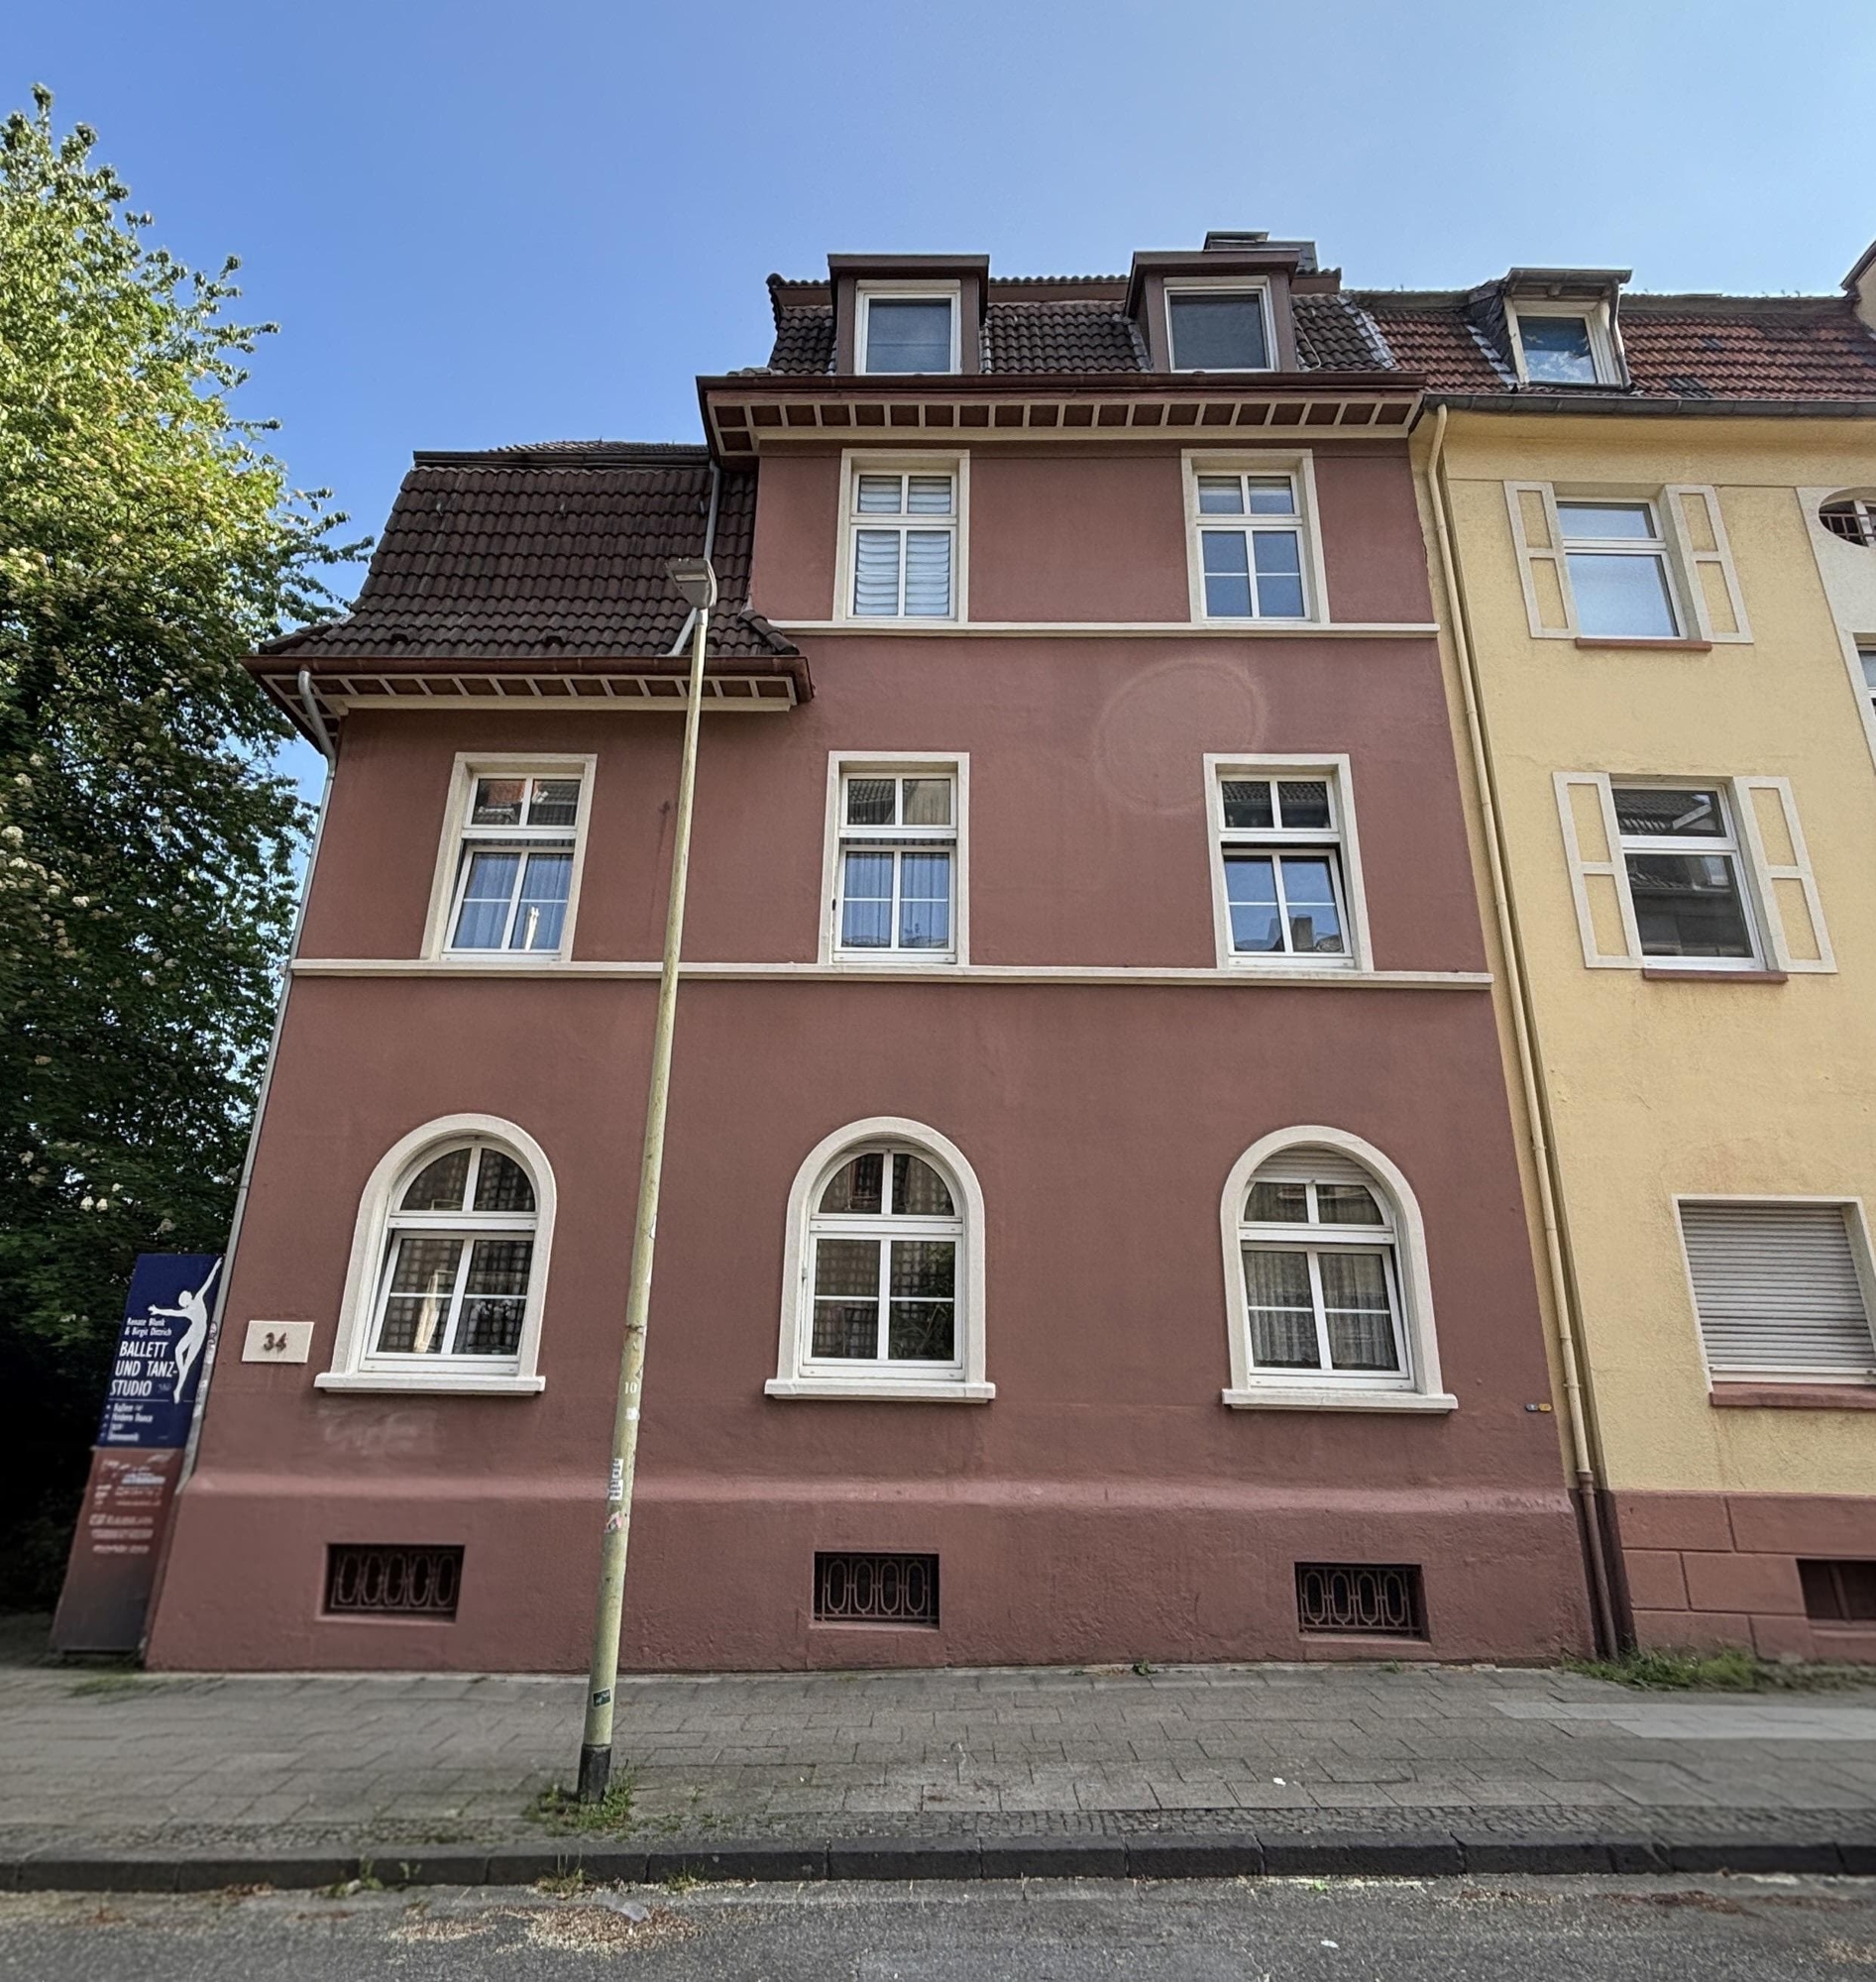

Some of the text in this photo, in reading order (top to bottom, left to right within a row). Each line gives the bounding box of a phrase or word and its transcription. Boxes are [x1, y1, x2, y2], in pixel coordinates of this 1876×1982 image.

[120, 1341, 168, 1358] BALLETT
[264, 1332, 287, 1351] 34
[115, 1360, 177, 1377] UND TANZ-
[109, 1379, 153, 1396] STUDIO
[624, 1380, 637, 1394] 10
